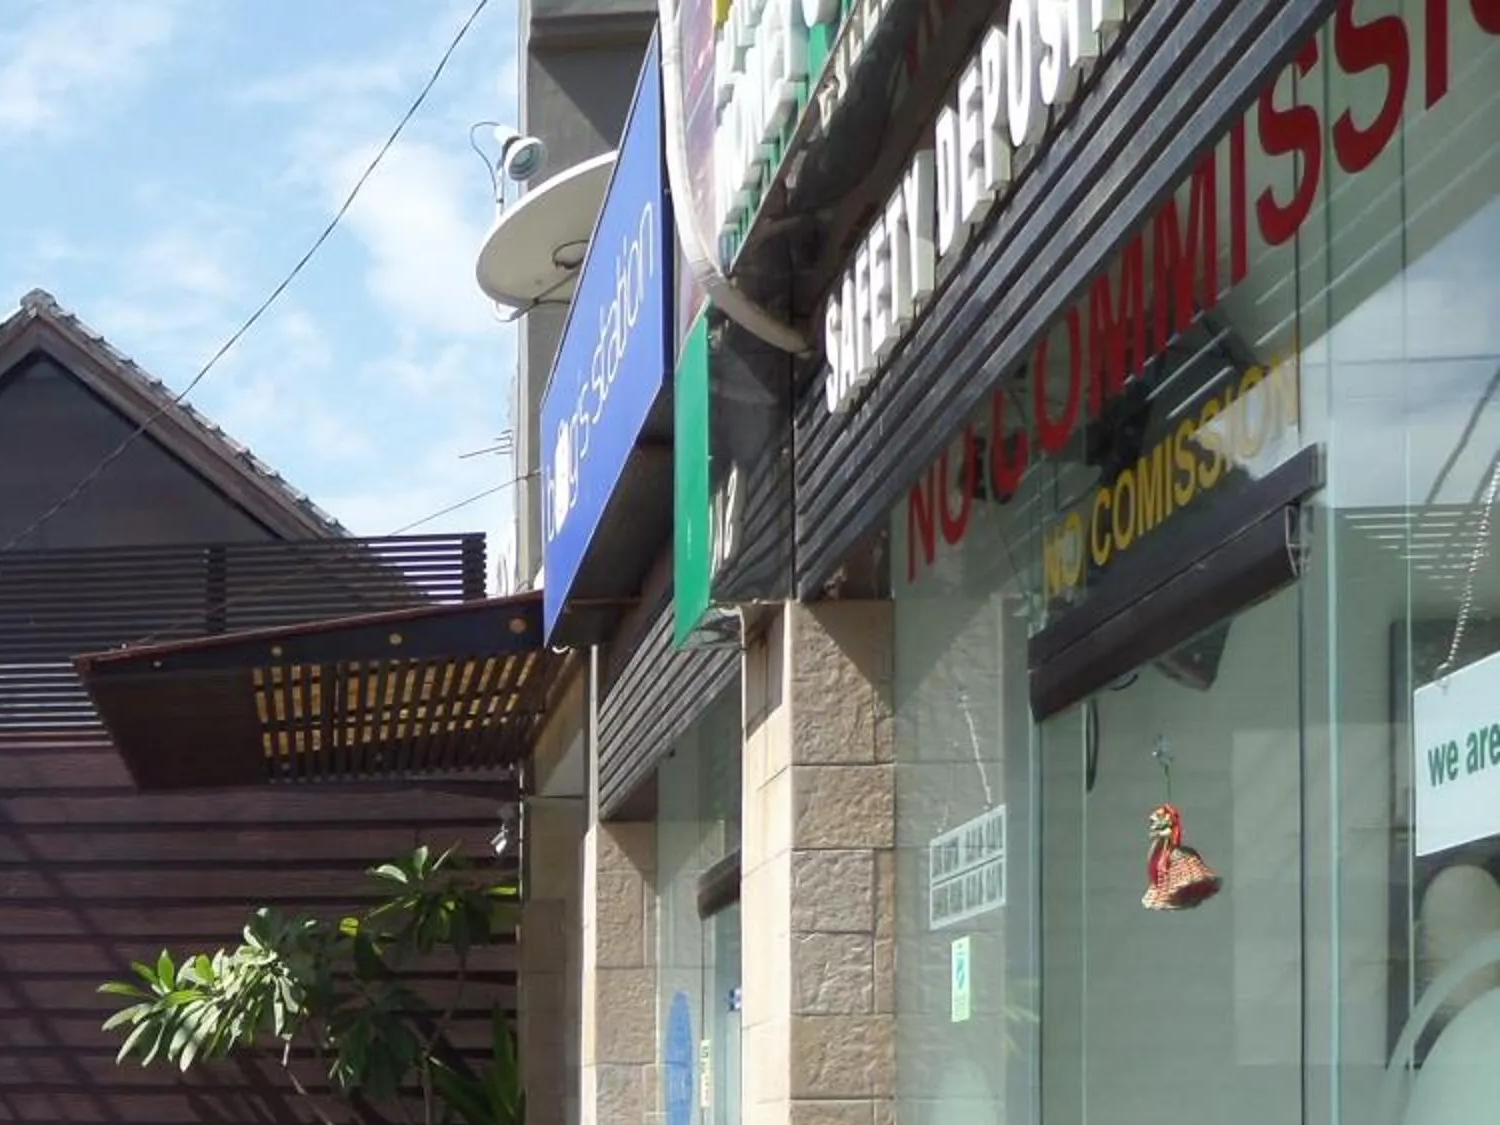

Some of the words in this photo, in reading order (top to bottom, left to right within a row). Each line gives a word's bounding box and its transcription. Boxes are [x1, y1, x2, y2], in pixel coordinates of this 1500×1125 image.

[591, 200, 654, 424] station
[825, 149, 930, 413] SAFETY
[935, 0, 1110, 256] DEPOS
[908, 420, 977, 583] NO
[990, 0, 1500, 494] COMMISS
[1427, 740, 1459, 787] we
[1466, 723, 1500, 775] are
